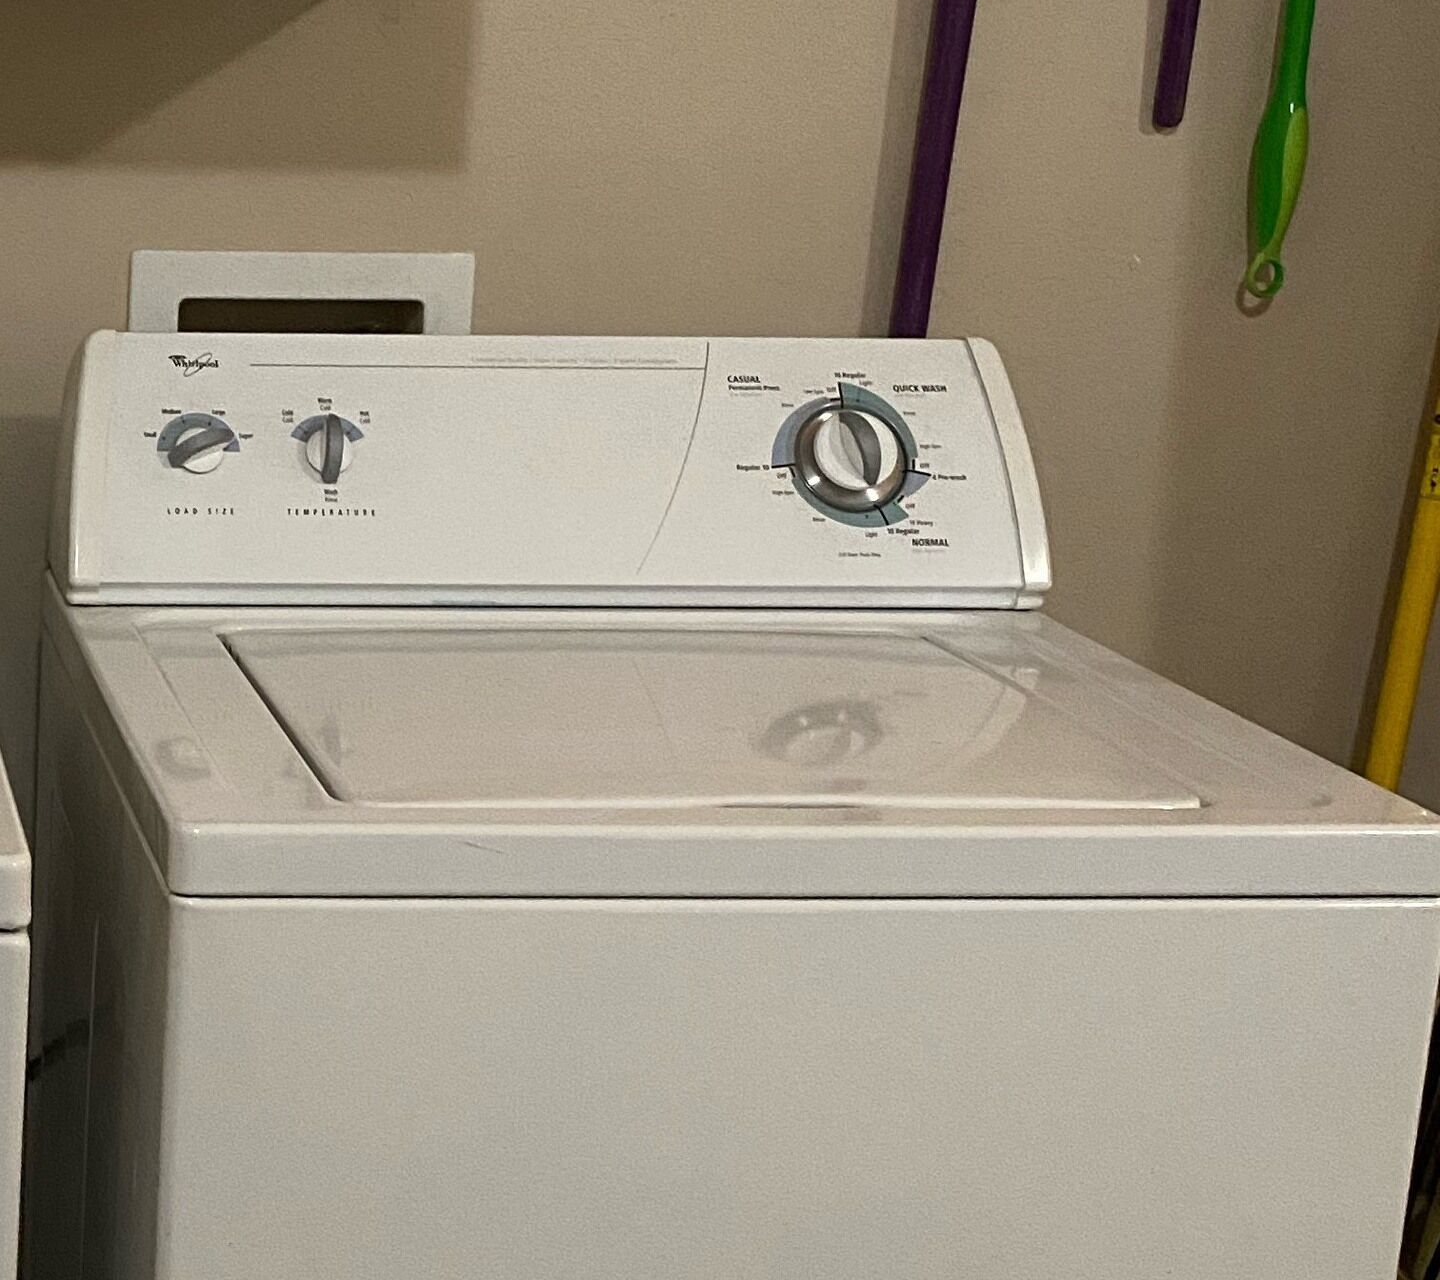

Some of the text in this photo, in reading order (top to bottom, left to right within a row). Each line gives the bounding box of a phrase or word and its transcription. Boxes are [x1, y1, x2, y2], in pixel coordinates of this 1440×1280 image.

[168, 354, 219, 373] Whirlpool
[727, 375, 761, 383] CASUAL
[892, 384, 947, 393] QUICK WASH
[167, 507, 234, 515] LOAD SIZE
[287, 508, 375, 517] TEMPERATURE
[911, 538, 950, 548] NORMAL
